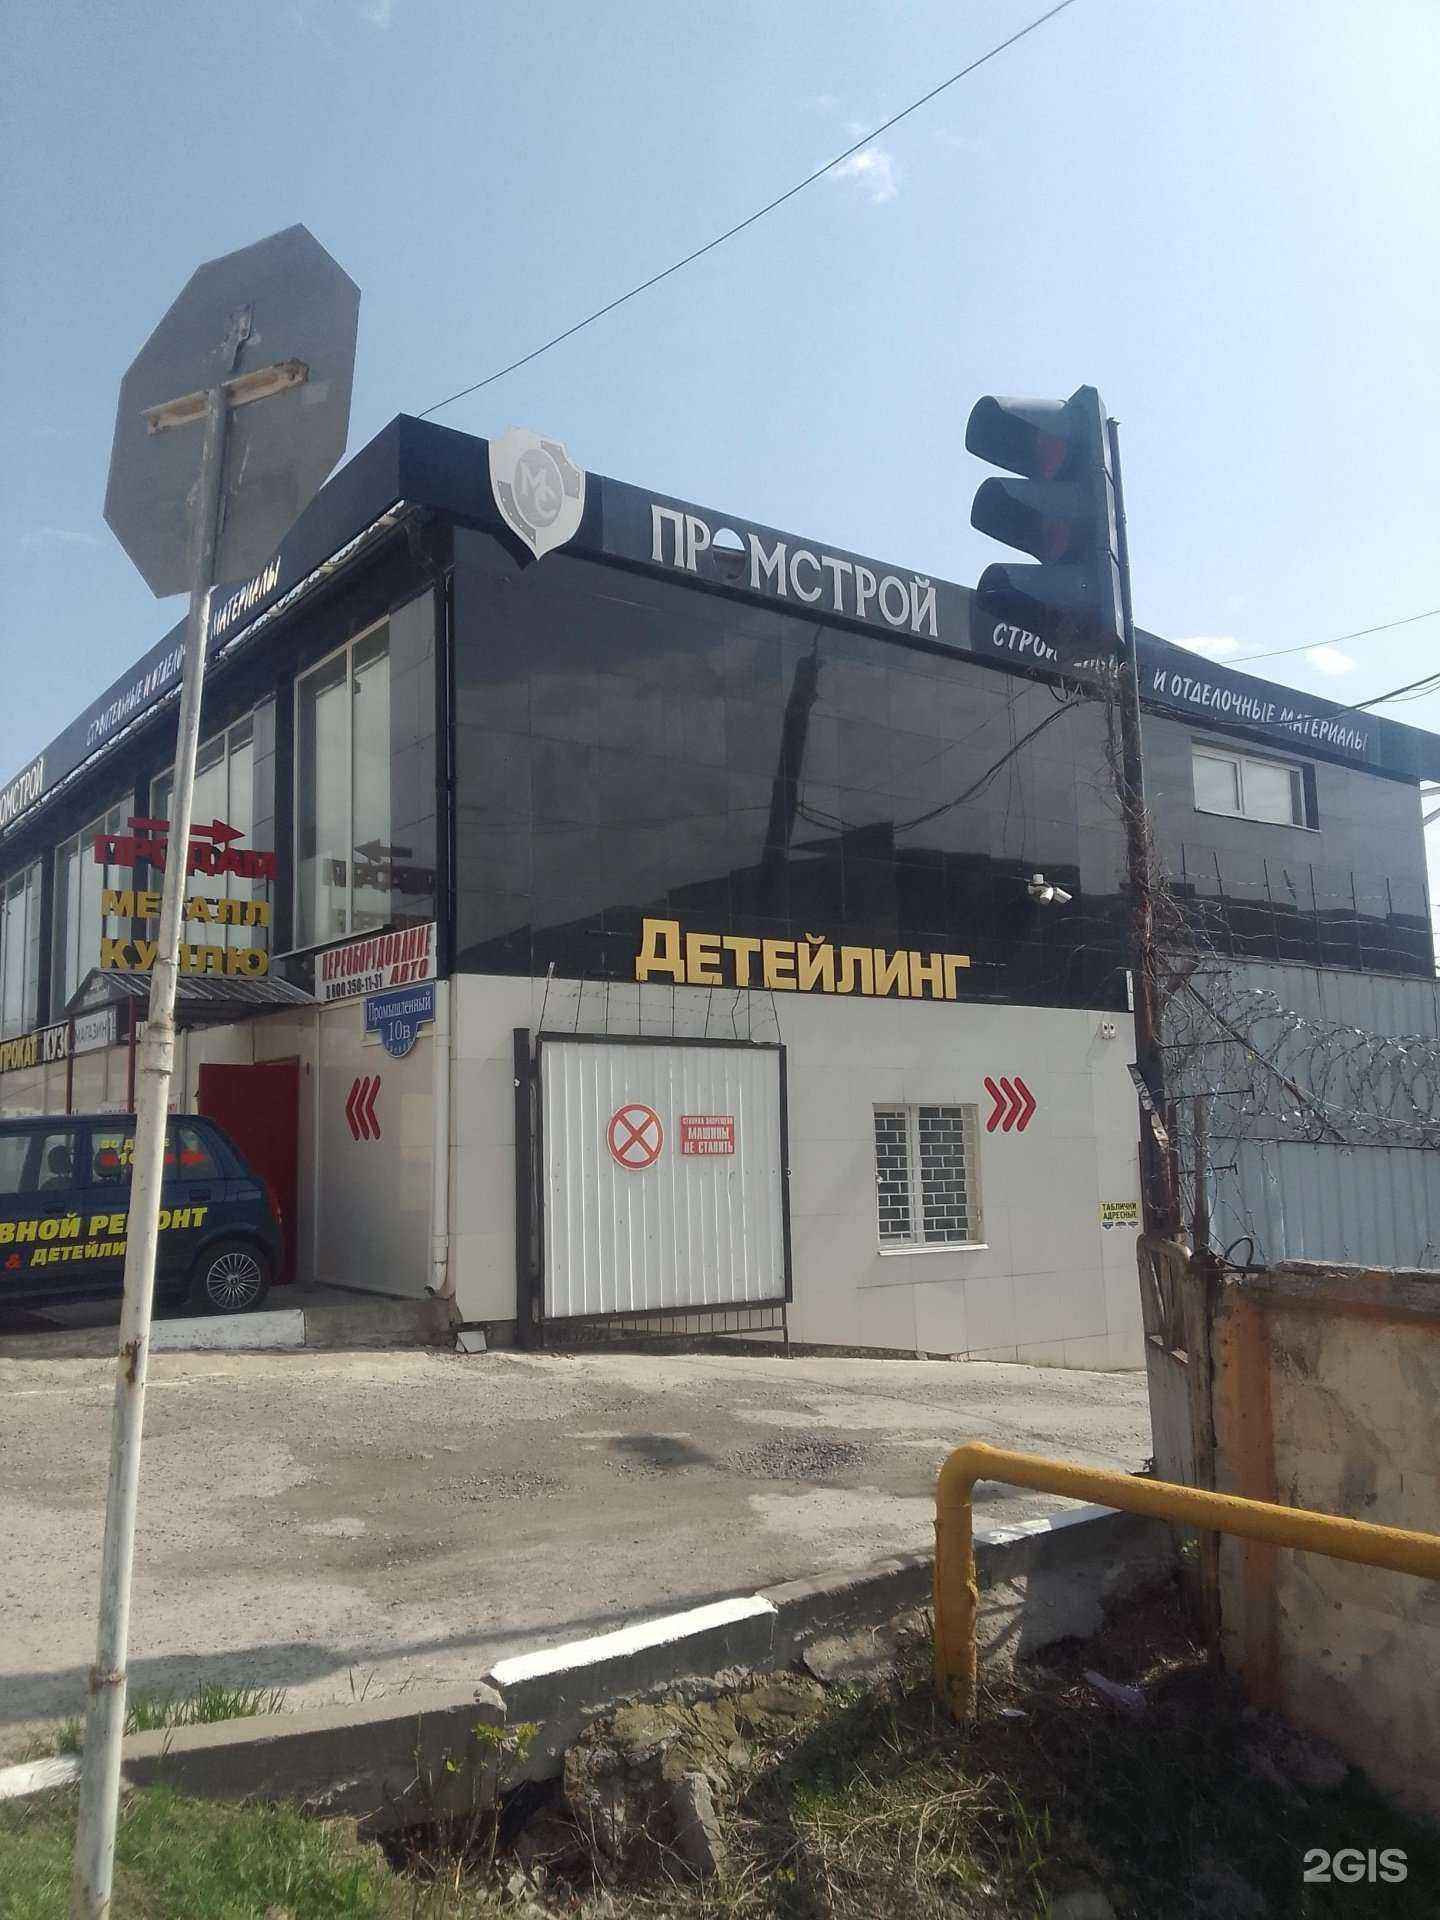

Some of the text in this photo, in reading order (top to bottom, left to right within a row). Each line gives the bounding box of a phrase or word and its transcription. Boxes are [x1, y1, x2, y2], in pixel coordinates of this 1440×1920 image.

[1153, 668, 1166, 692] И
[1171, 675, 1276, 722] ОТДЕЛОЧНЫЕ
[1280, 708, 1368, 751] МАТЕРИАЛЫ
[101, 889, 270, 928] МЕАЛЛ
[322, 925, 432, 981] ПЕРЕОБОРУДОВАНИЕ
[390, 958, 428, 985] АВТО
[368, 991, 432, 1024] Промышленный
[688, 1127, 730, 1140] МАШИНЫ
[698, 1141, 734, 1153] СТАВИТЬ
[1102, 1202, 1137, 1211] ТАБЛИЧКИ
[0, 1208, 208, 1243] ВНОЙ РЕОНТ
[30, 1241, 127, 1267] ДЕТЕЙЛИ
